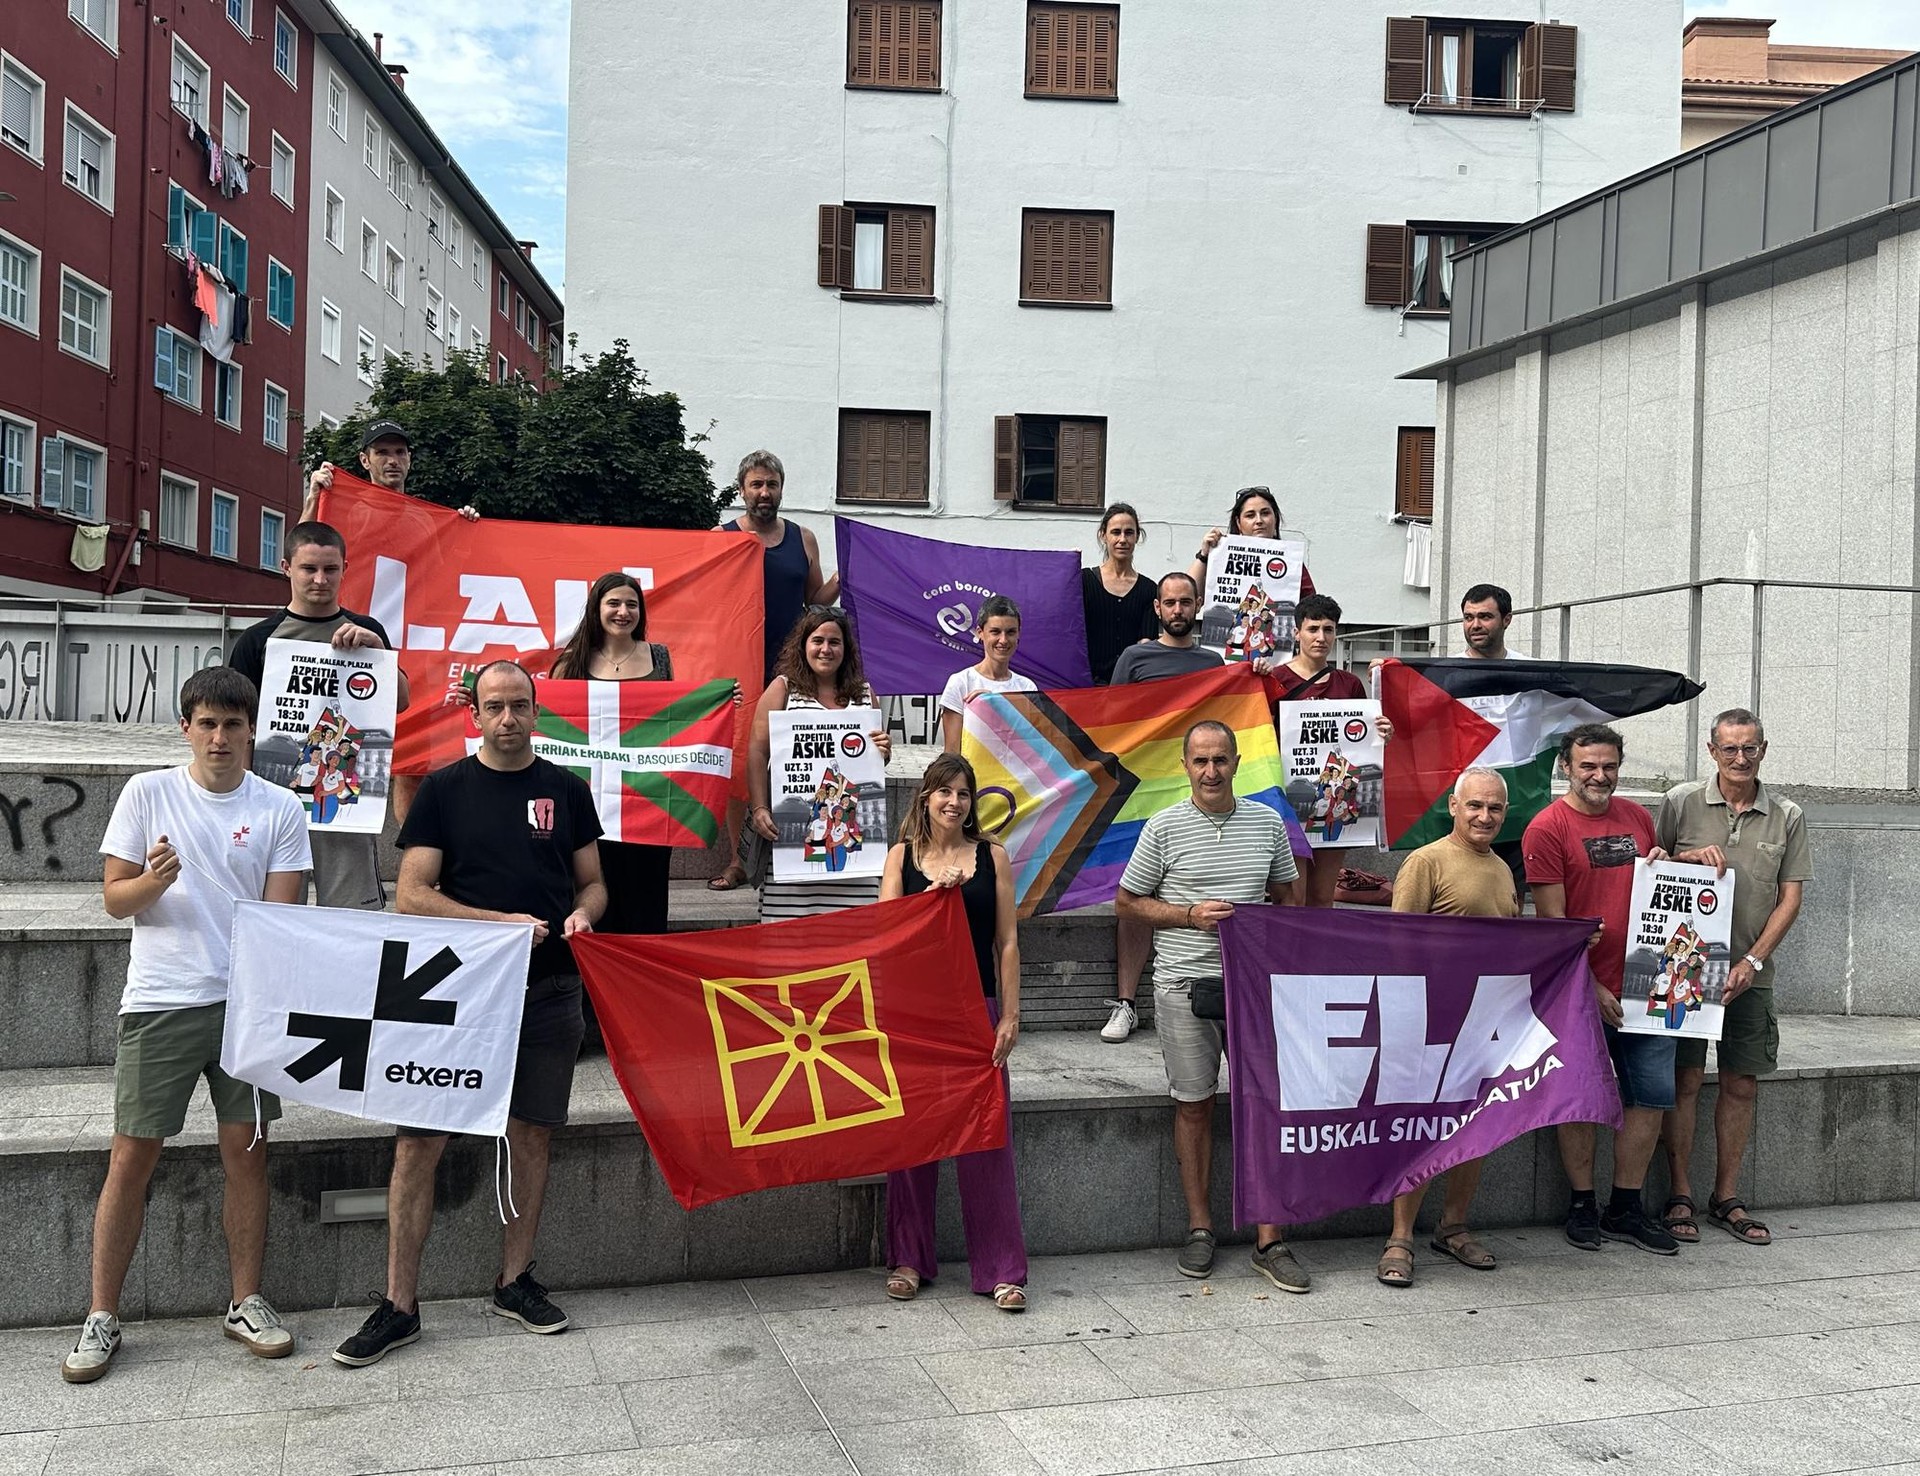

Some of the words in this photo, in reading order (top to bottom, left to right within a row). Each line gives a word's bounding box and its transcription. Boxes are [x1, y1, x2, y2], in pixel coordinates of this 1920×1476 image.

[1228, 553, 1260, 563] AZPEITIA
[1225, 560, 1261, 577] ASKE
[1217, 577, 1232, 585] UZT.
[1233, 578, 1241, 586] 31
[1219, 586, 1238, 595] 18:30
[1213, 595, 1241, 604] PLAZAN
[292, 665, 337, 679] AZPEITIA
[286, 675, 340, 698] ASKE
[276, 697, 297, 708] UZT.
[298, 699, 309, 709] 31
[278, 709, 305, 721] 18:30
[270, 721, 310, 734] PLAZAN
[1302, 720, 1337, 729] AZPEITIA
[794, 733, 833, 742] AZPEITIA
[1300, 728, 1338, 744] ASKE
[792, 741, 835, 759] ASKE
[1293, 748, 1308, 756] UZT.
[1309, 747, 1318, 755] 31
[580, 749, 630, 763] ERABAKI
[637, 753, 688, 765] BASQUES
[690, 752, 725, 767] DECIDE
[1295, 758, 1315, 766] 18:30
[784, 763, 802, 772] UZT.
[804, 763, 813, 771] 31
[1291, 767, 1320, 776] PLAZAN
[787, 774, 810, 783] 18:30
[783, 785, 816, 794] PLAZAN
[1655, 883, 1691, 895] AZPEITIA
[1650, 892, 1692, 913] ASKE
[1641, 912, 1657, 922] UZT.
[1659, 914, 1668, 923] 31
[1642, 924, 1663, 934] 18:30
[1636, 935, 1667, 946] PLAZAN
[1270, 974, 1558, 1111] ELA
[385, 1061, 483, 1089] etxera
[1280, 1118, 1380, 1153] EUSKAL
